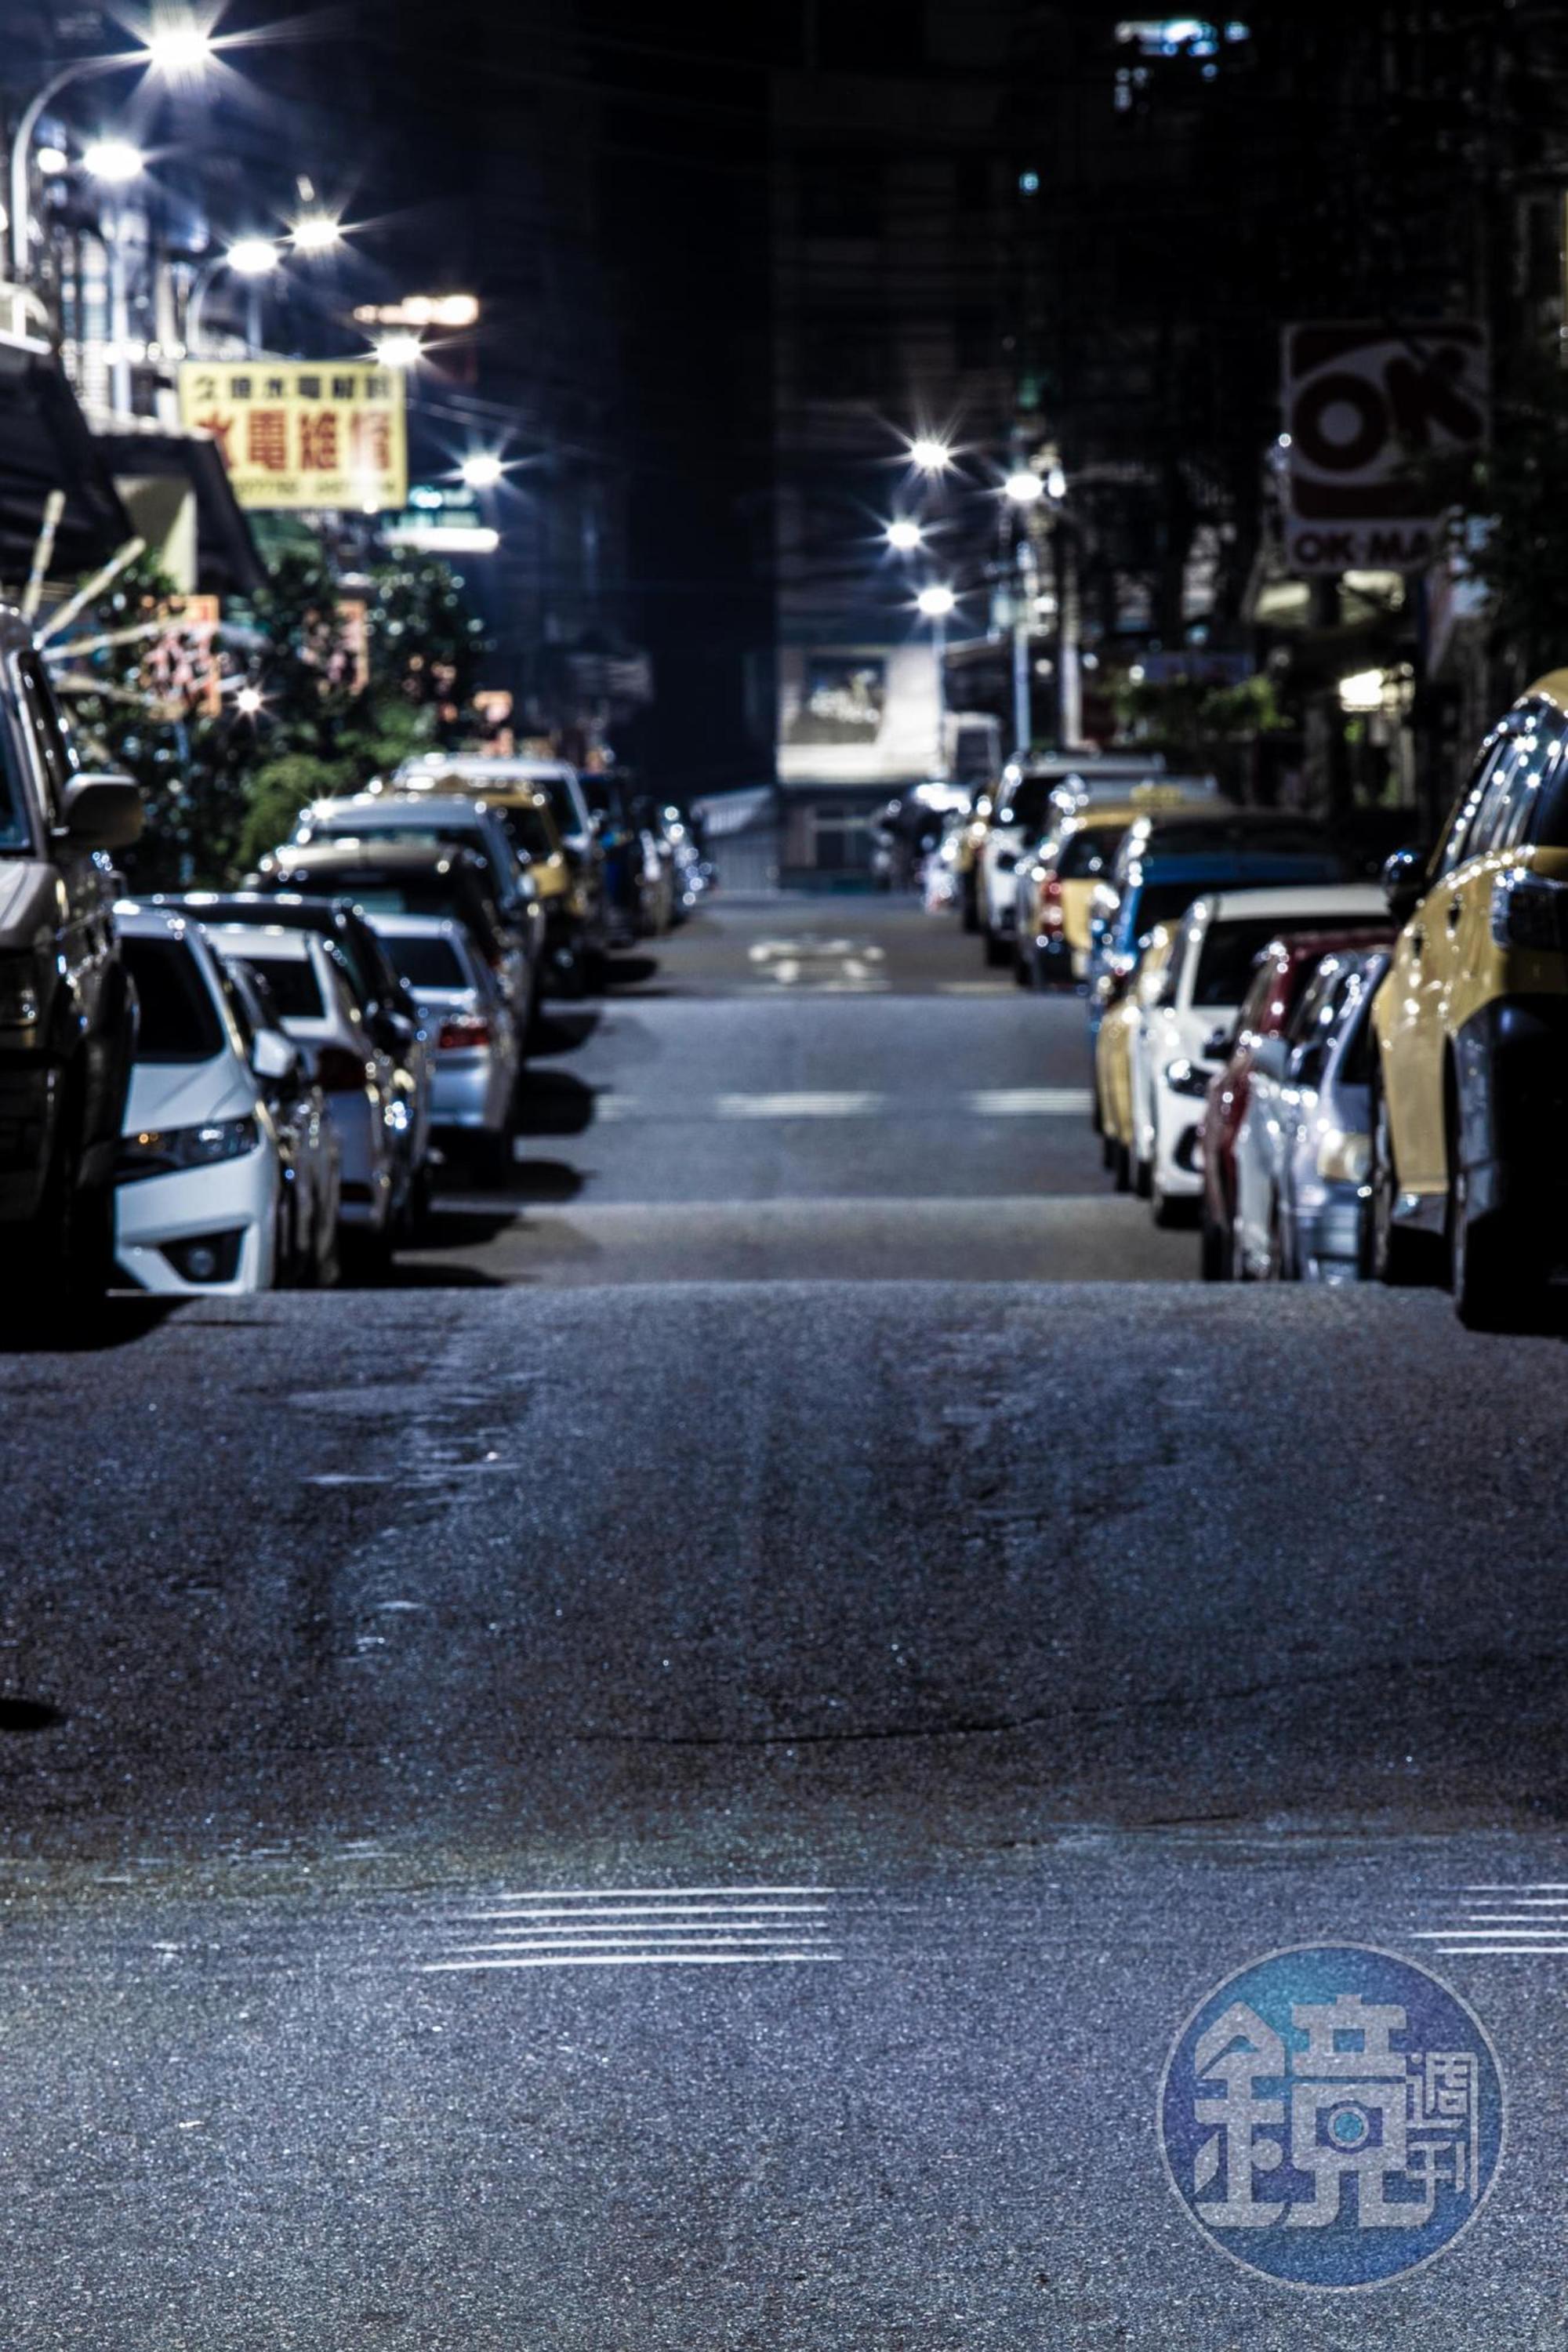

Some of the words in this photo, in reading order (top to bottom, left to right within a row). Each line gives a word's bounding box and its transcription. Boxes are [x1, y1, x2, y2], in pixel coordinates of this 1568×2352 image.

[1294, 347, 1483, 470] OK
[1294, 532, 1354, 564] OK
[1369, 528, 1432, 561] MA
